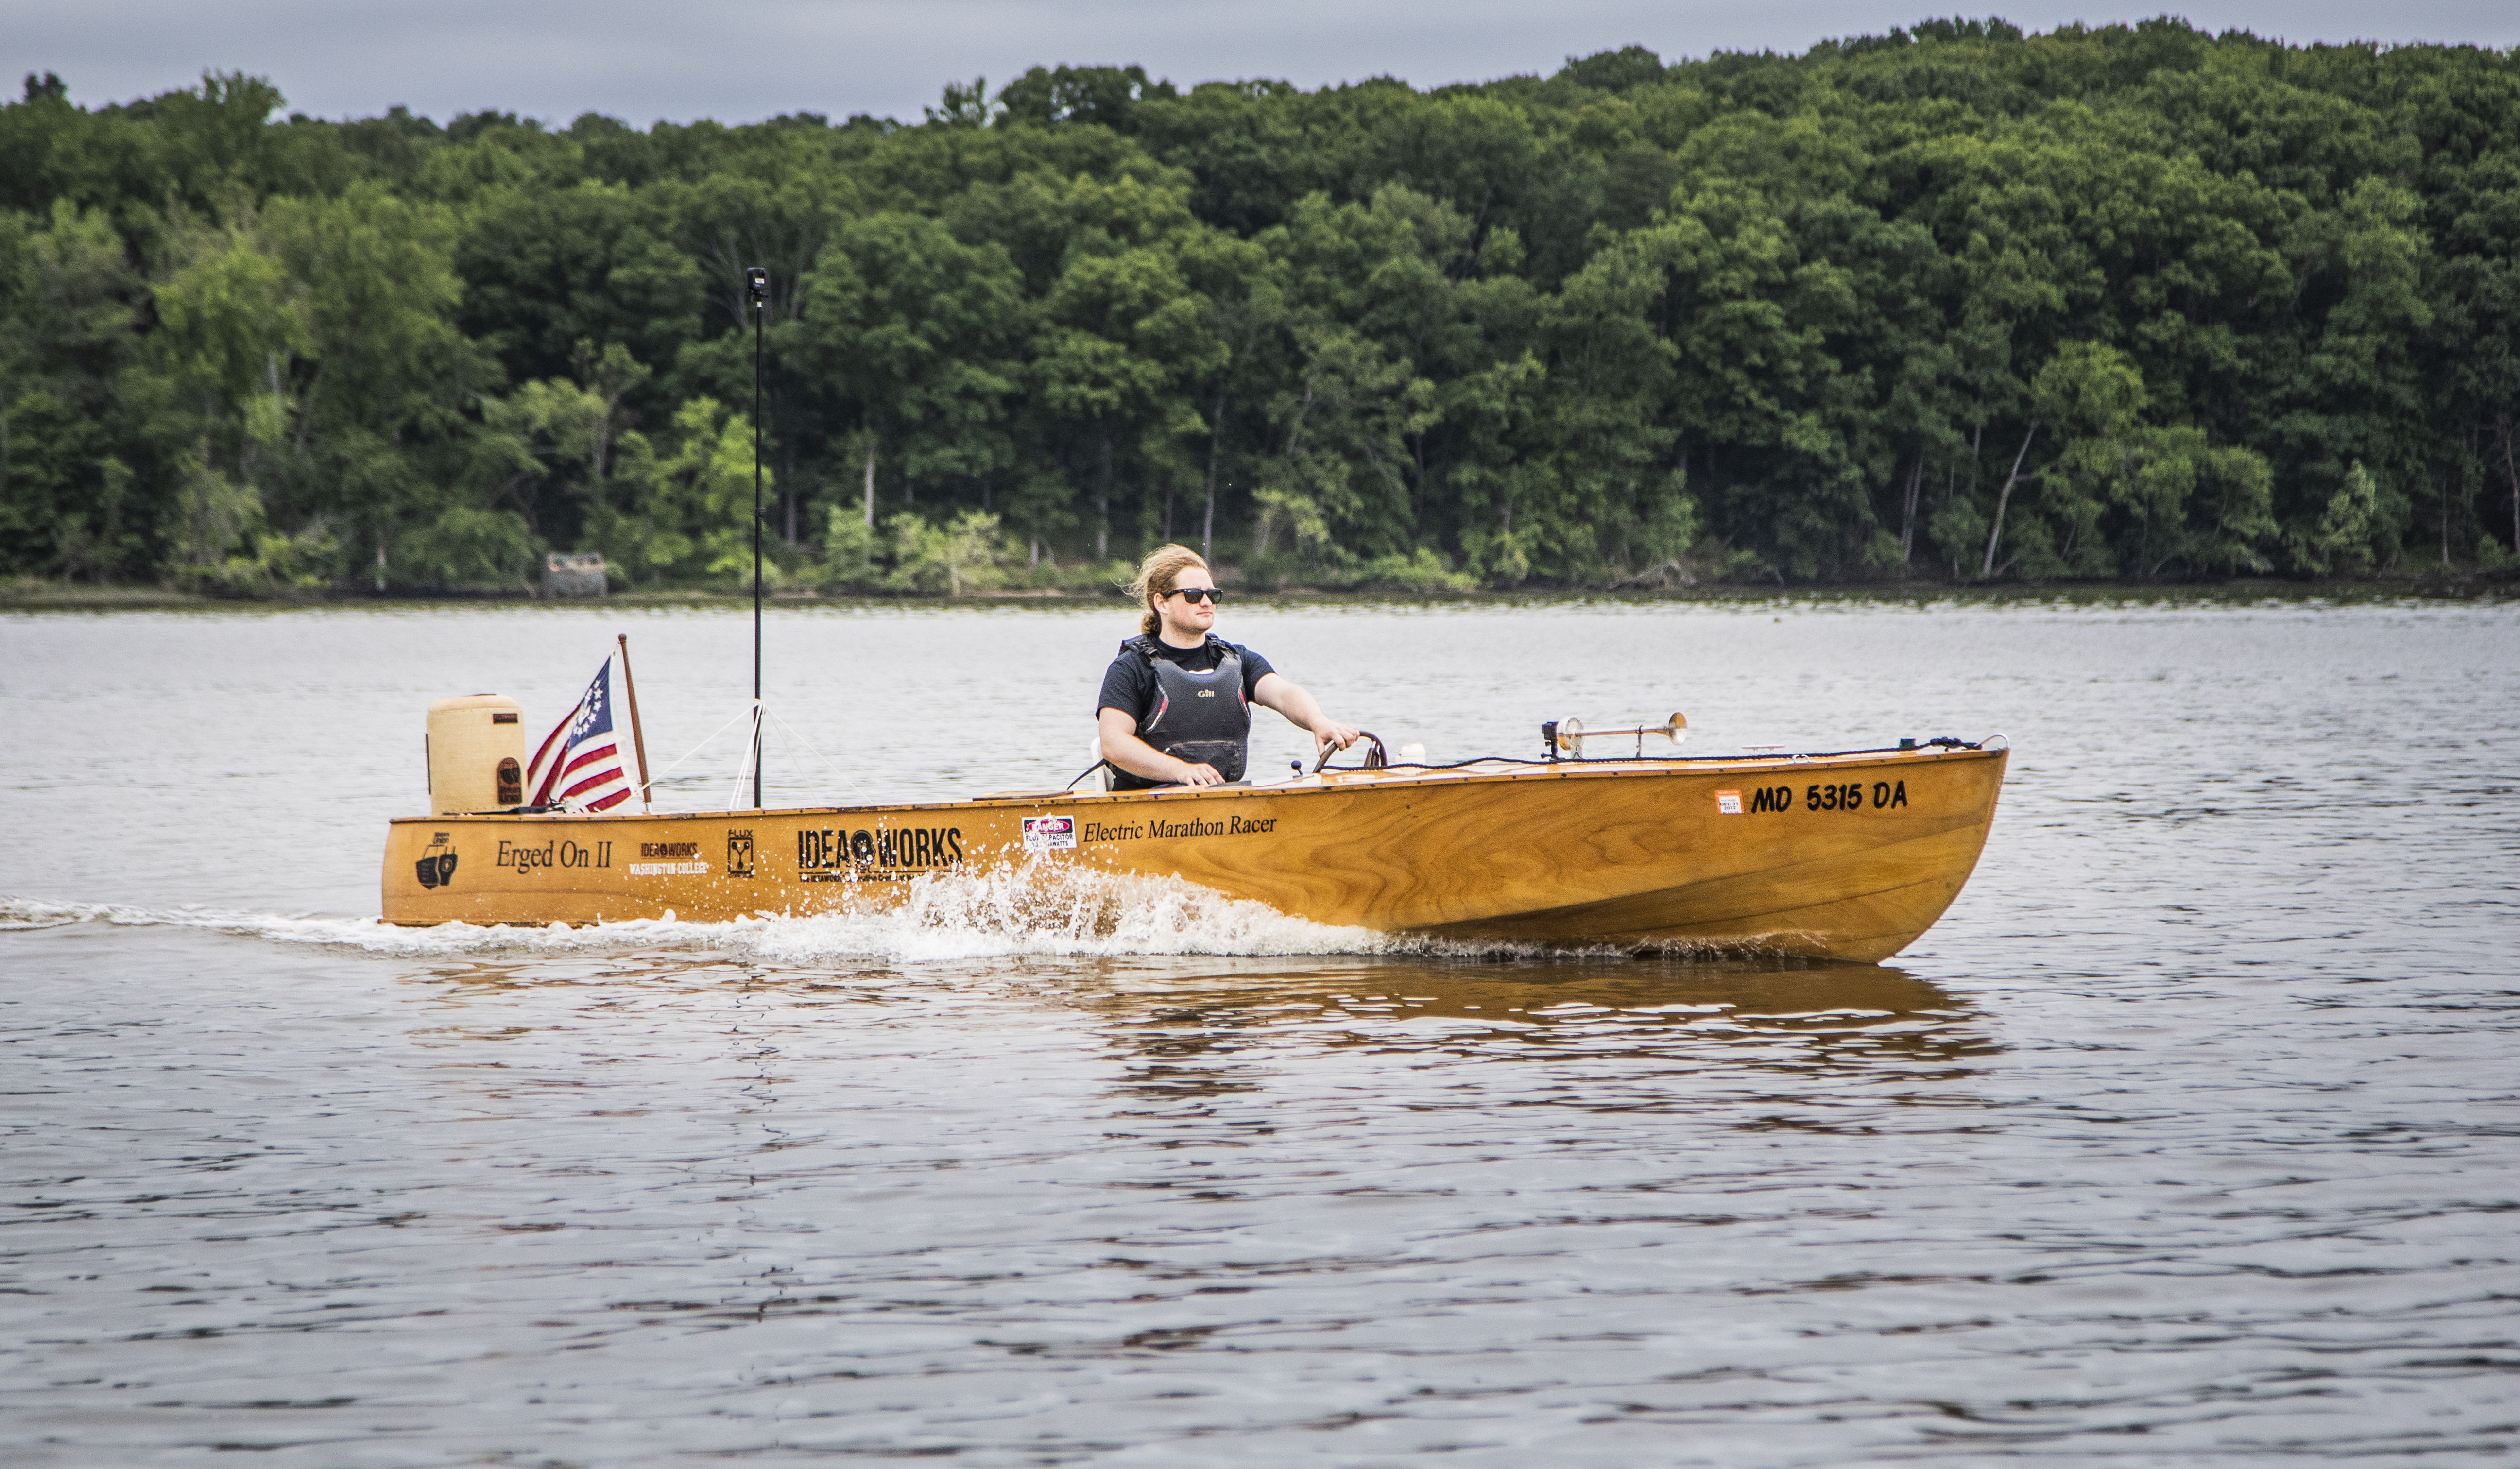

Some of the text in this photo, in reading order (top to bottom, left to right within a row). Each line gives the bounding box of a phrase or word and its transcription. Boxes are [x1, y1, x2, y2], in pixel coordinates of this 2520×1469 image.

[1197, 689, 1215, 697] Gill
[1751, 780, 1908, 814] MD 5315 DA
[728, 829, 753, 837] FLUX
[1083, 815, 1277, 842] Electric Marathon Racer
[496, 840, 613, 874] Erged On II
[629, 862, 708, 875] WASHINGTON COLLEGE
